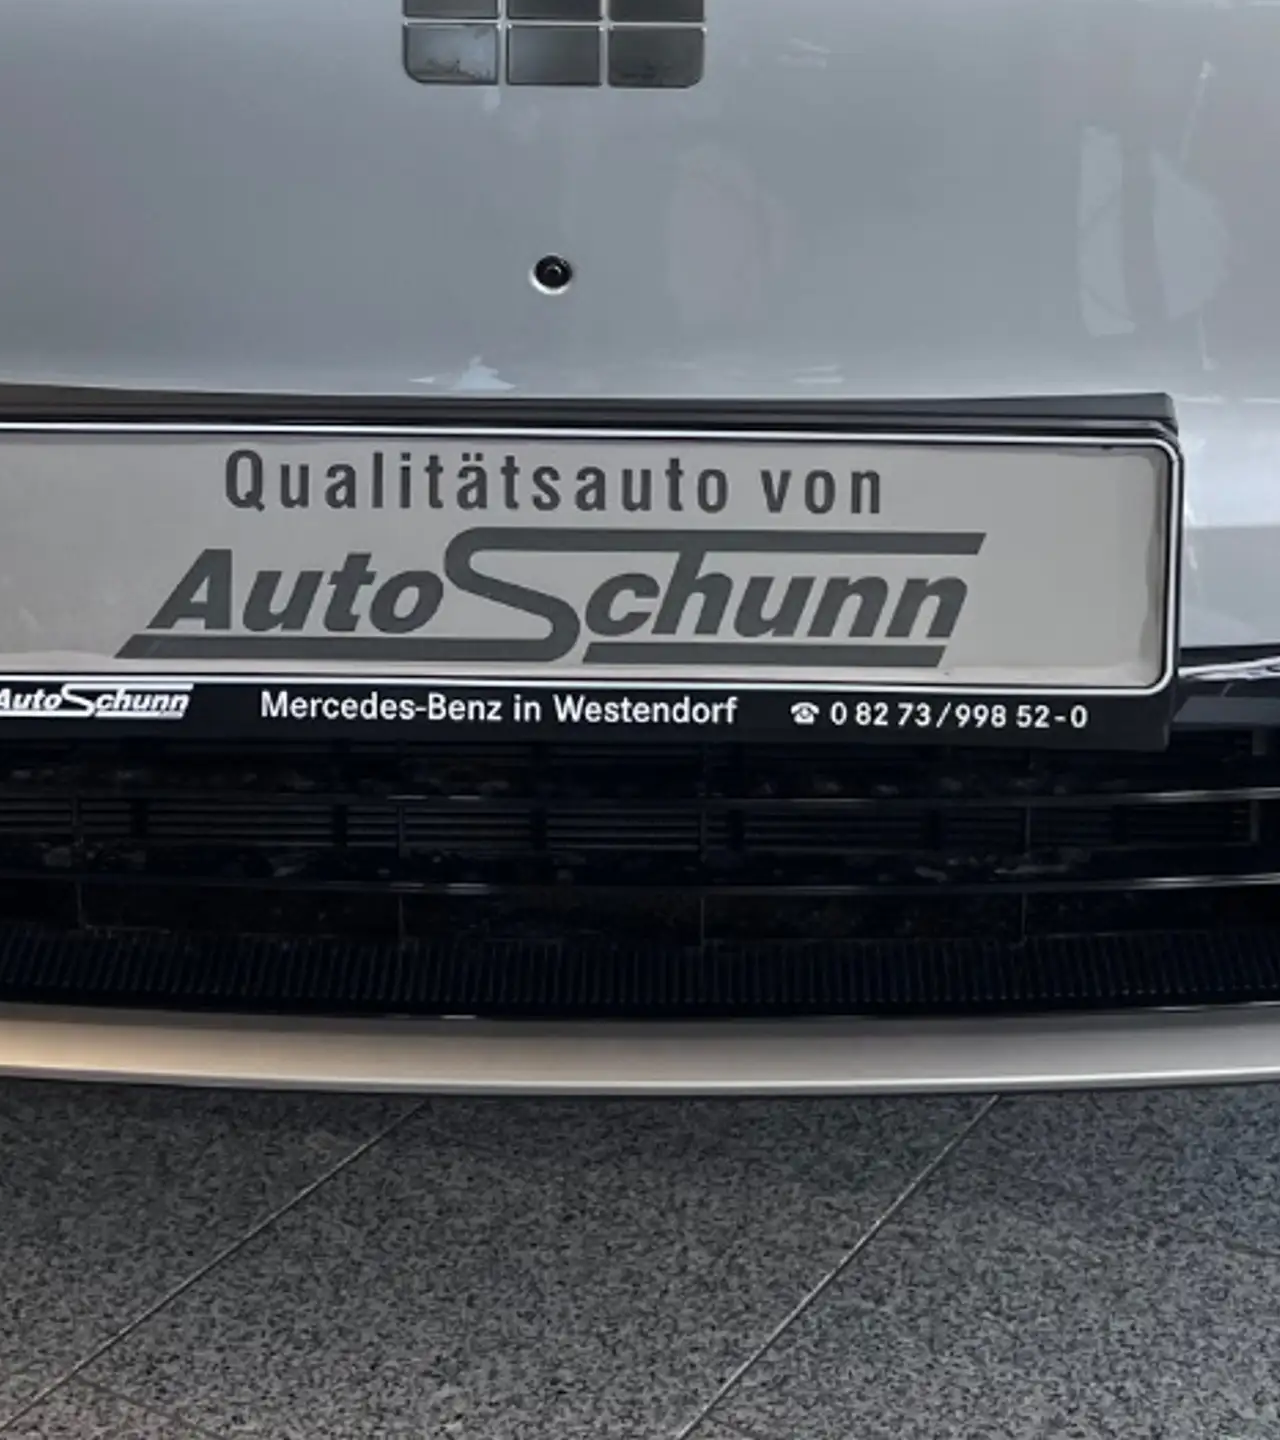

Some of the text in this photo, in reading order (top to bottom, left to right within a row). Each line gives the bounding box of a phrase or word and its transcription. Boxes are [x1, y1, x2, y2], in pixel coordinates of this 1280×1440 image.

[224, 449, 881, 515] Qualitätsauto von
[260, 690, 738, 724] Mercedes-Benz in Westendorf
